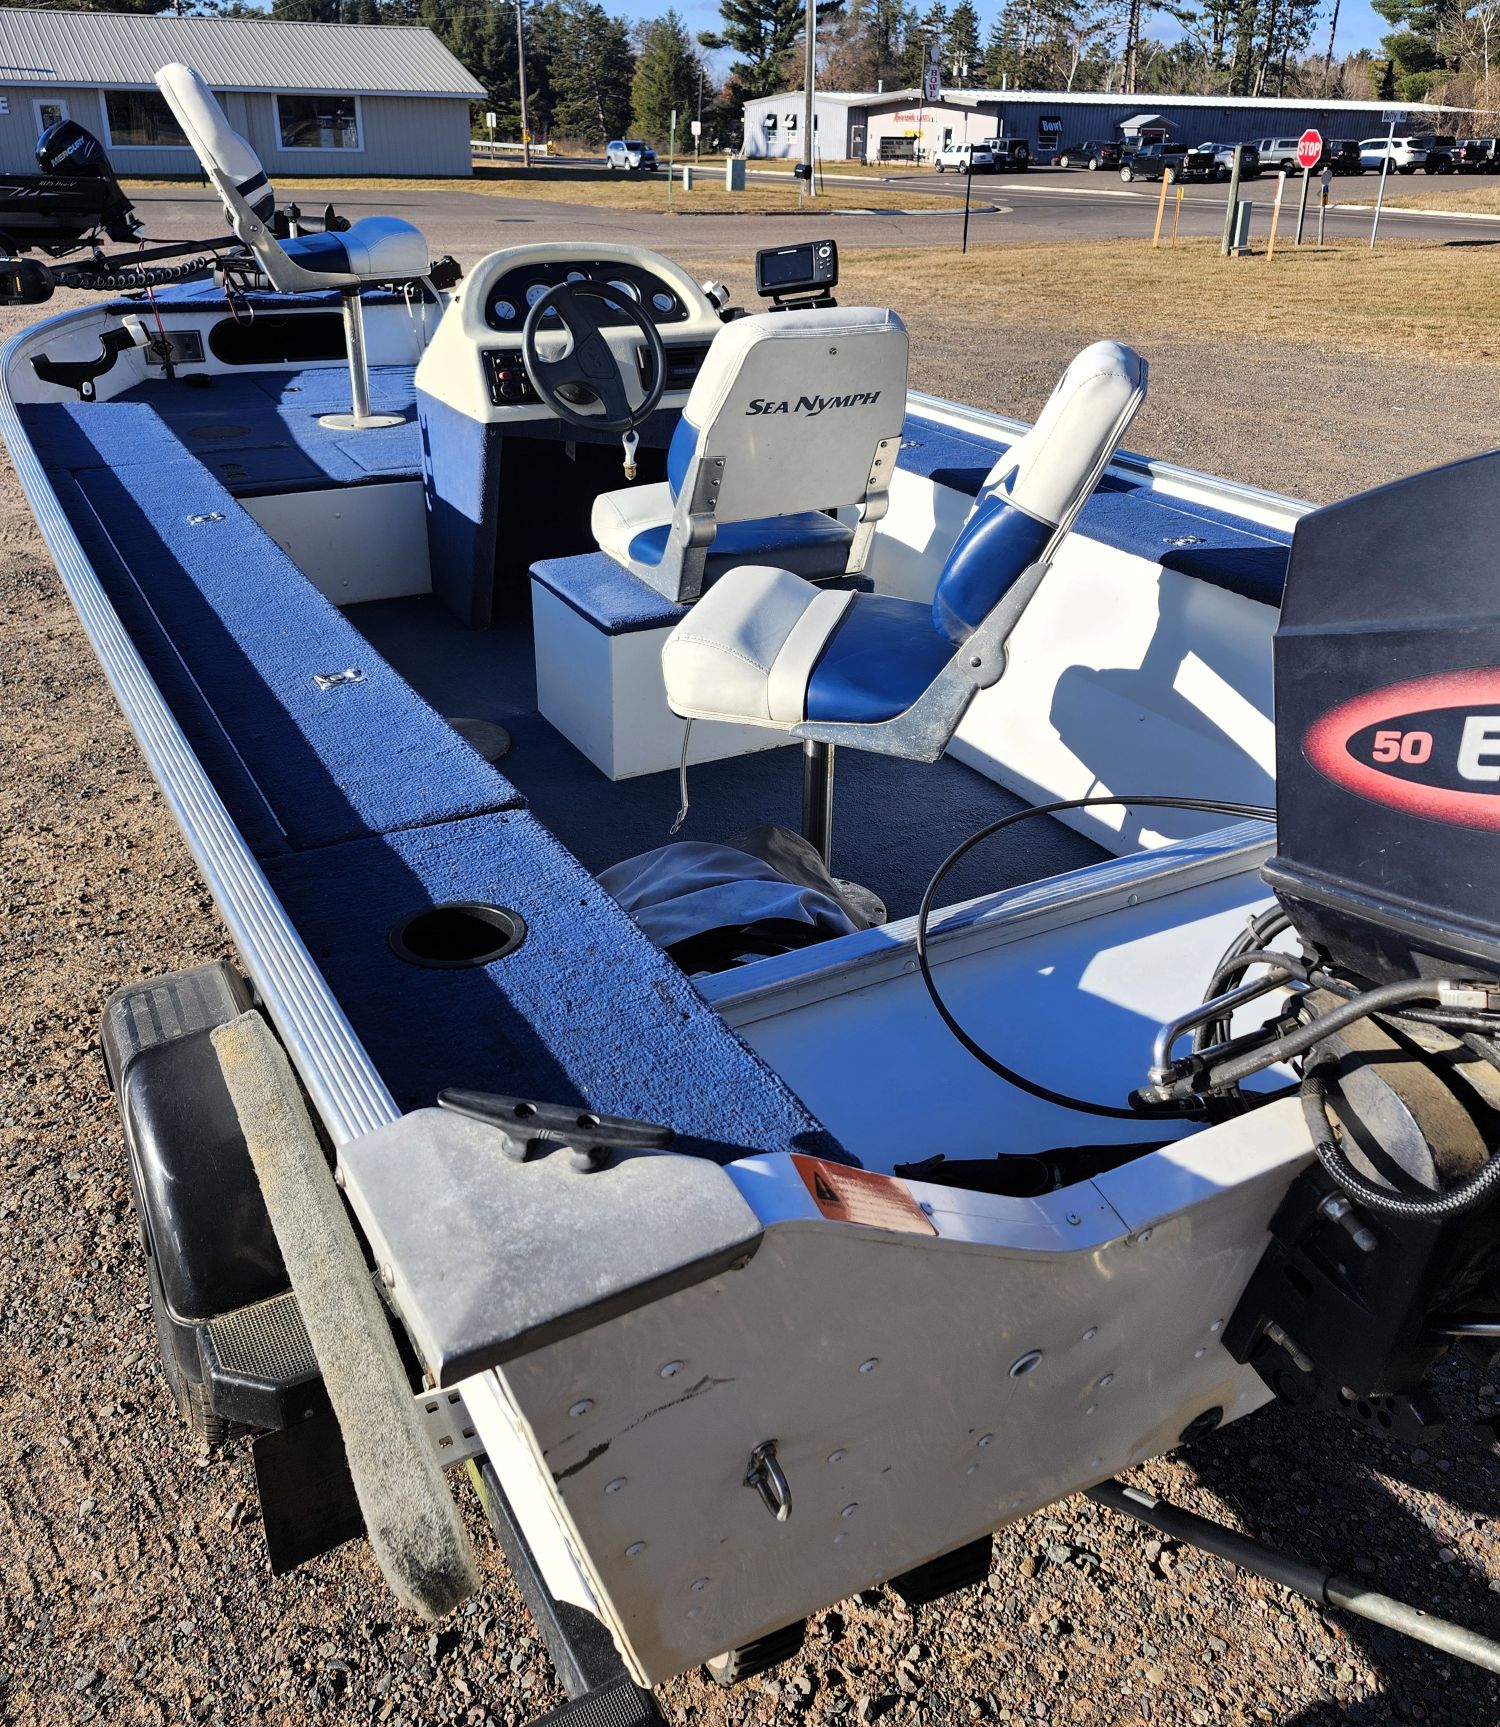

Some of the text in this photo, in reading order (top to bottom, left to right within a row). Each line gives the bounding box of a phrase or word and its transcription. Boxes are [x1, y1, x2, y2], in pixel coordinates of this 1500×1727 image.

[929, 70, 938, 98] BOWL
[51, 136, 84, 167] MERCURY
[1299, 141, 1320, 156] STOP
[745, 390, 882, 418] SEA NYMPH
[1372, 730, 1433, 765] 50
